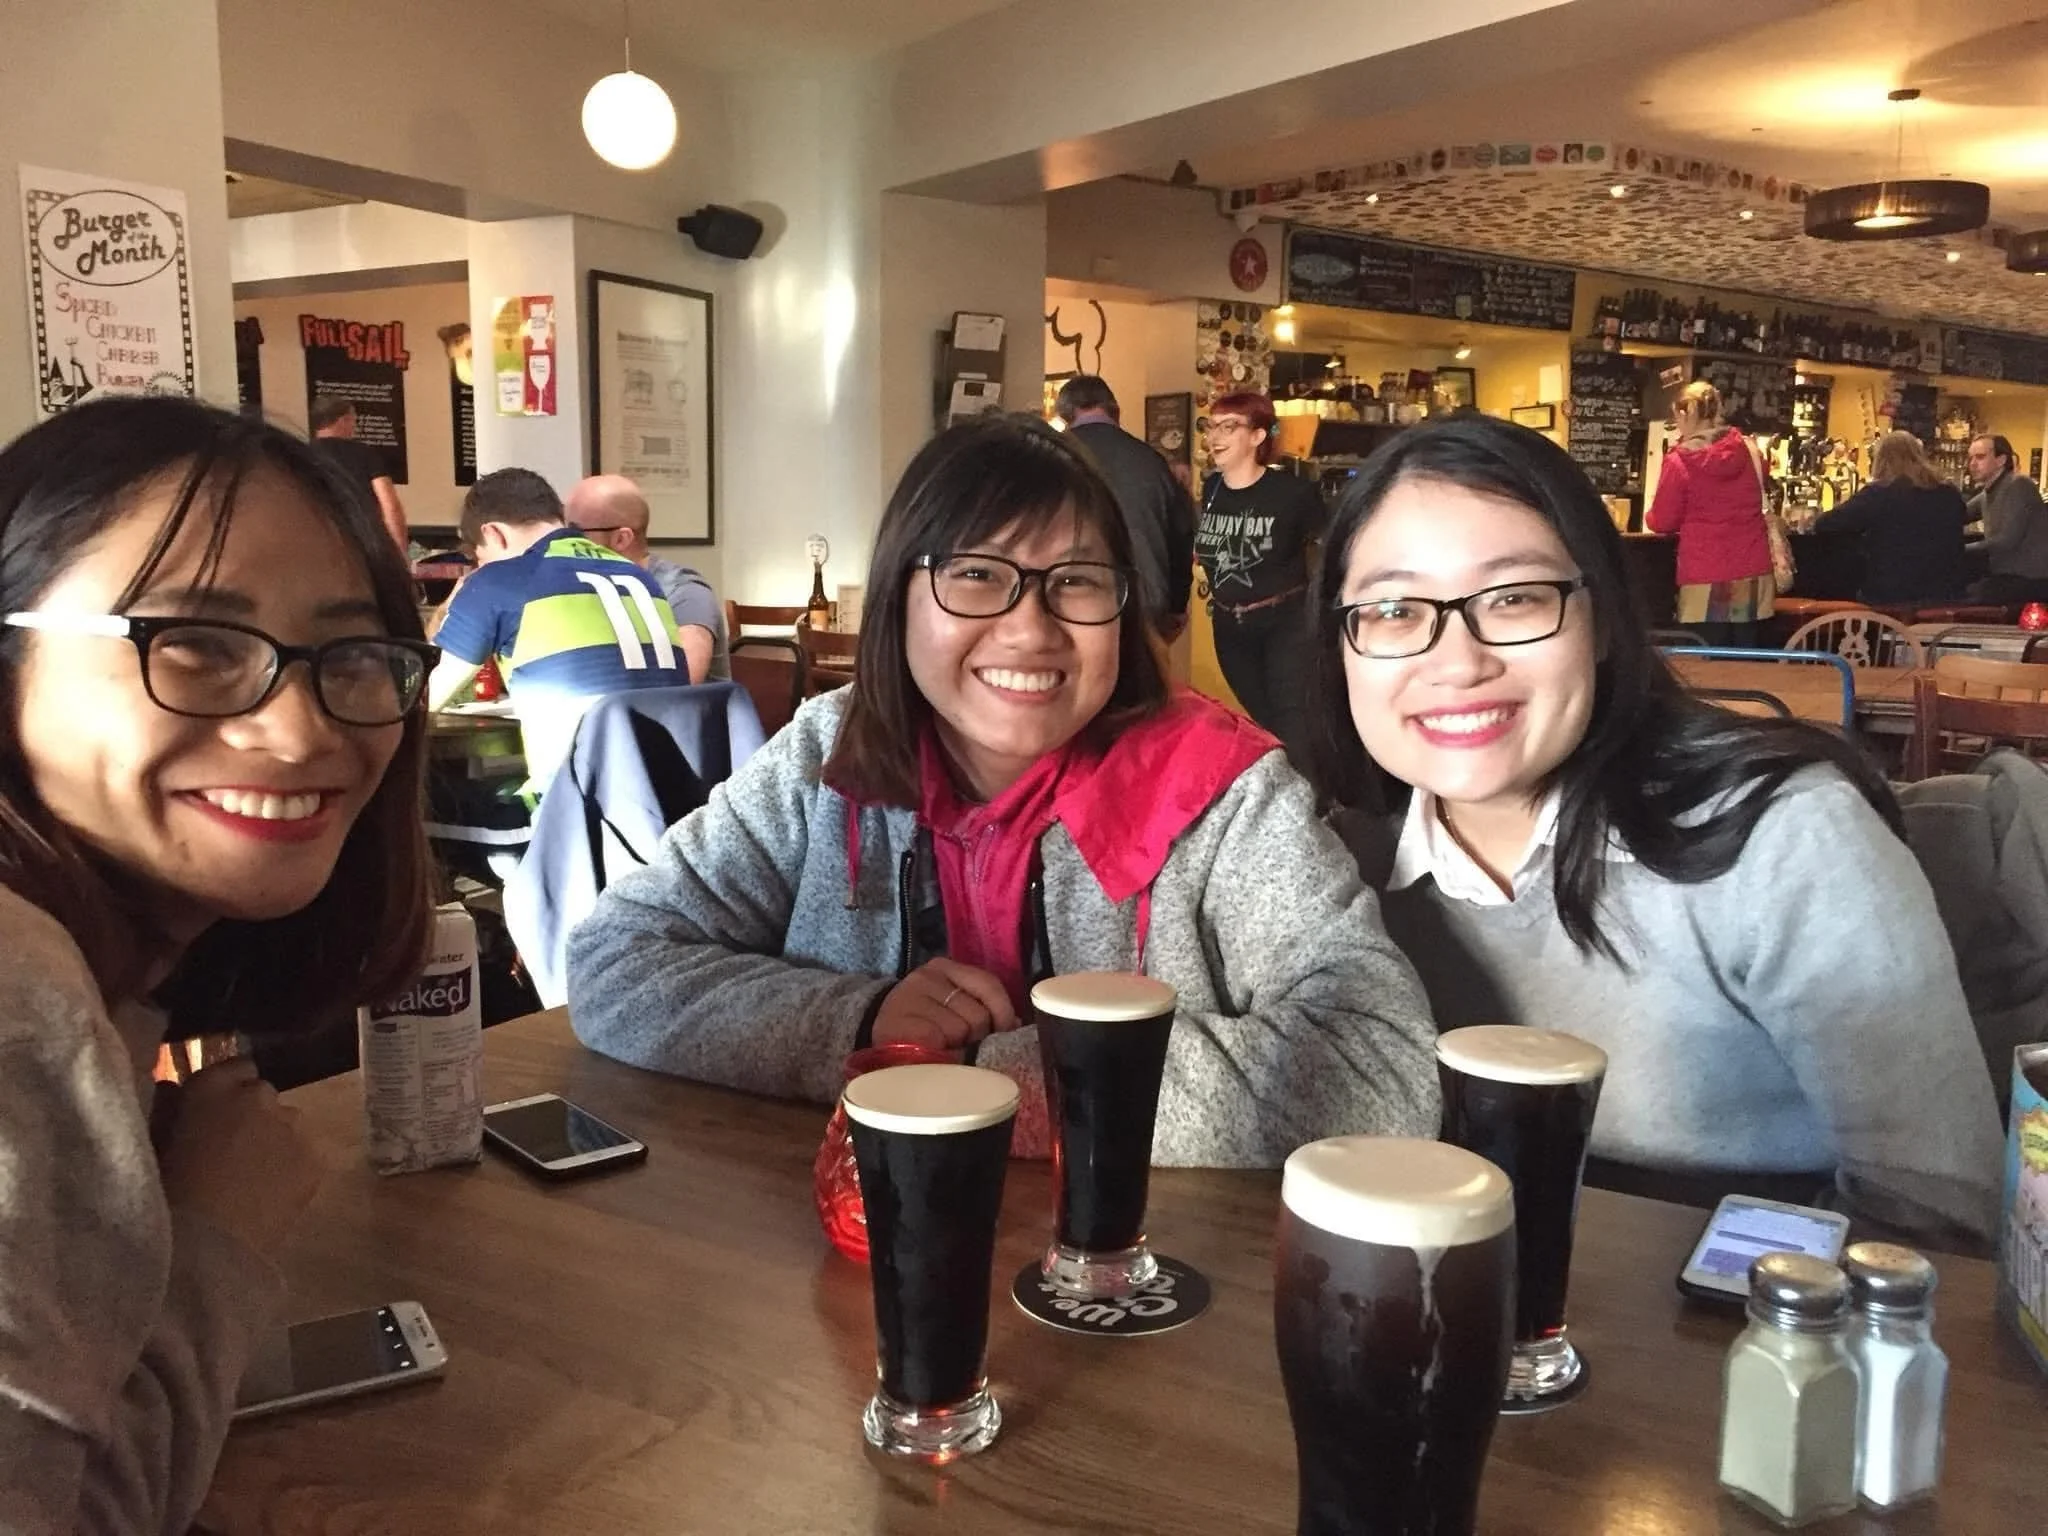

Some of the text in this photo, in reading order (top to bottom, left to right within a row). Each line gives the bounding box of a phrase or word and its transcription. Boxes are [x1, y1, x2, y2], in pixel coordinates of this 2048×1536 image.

[53, 208, 152, 249] Burger
[76, 235, 166, 276] Month
[1199, 512, 1276, 537] ALWAY BAY
[575, 571, 677, 670] 11
